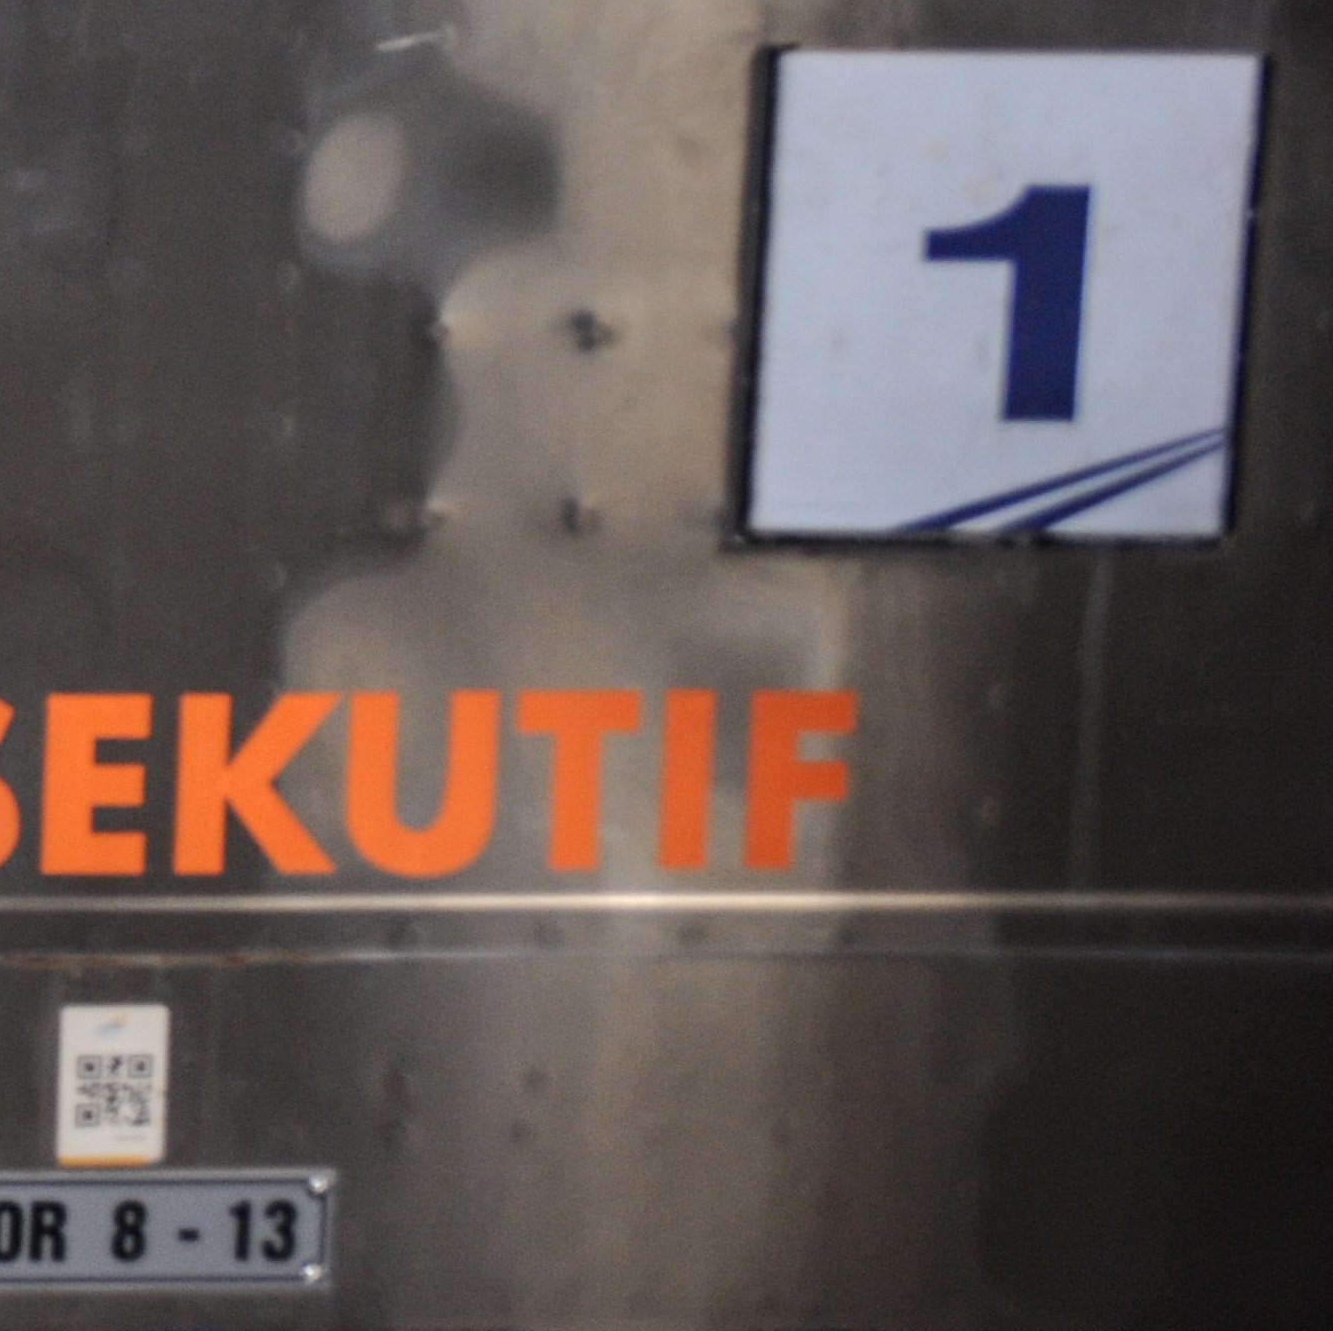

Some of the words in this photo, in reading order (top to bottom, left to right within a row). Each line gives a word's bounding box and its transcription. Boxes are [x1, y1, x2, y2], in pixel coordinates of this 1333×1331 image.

[923, 183, 1093, 424] 1
[108, 1198, 150, 1265] 8
[228, 1198, 301, 1265] 13
